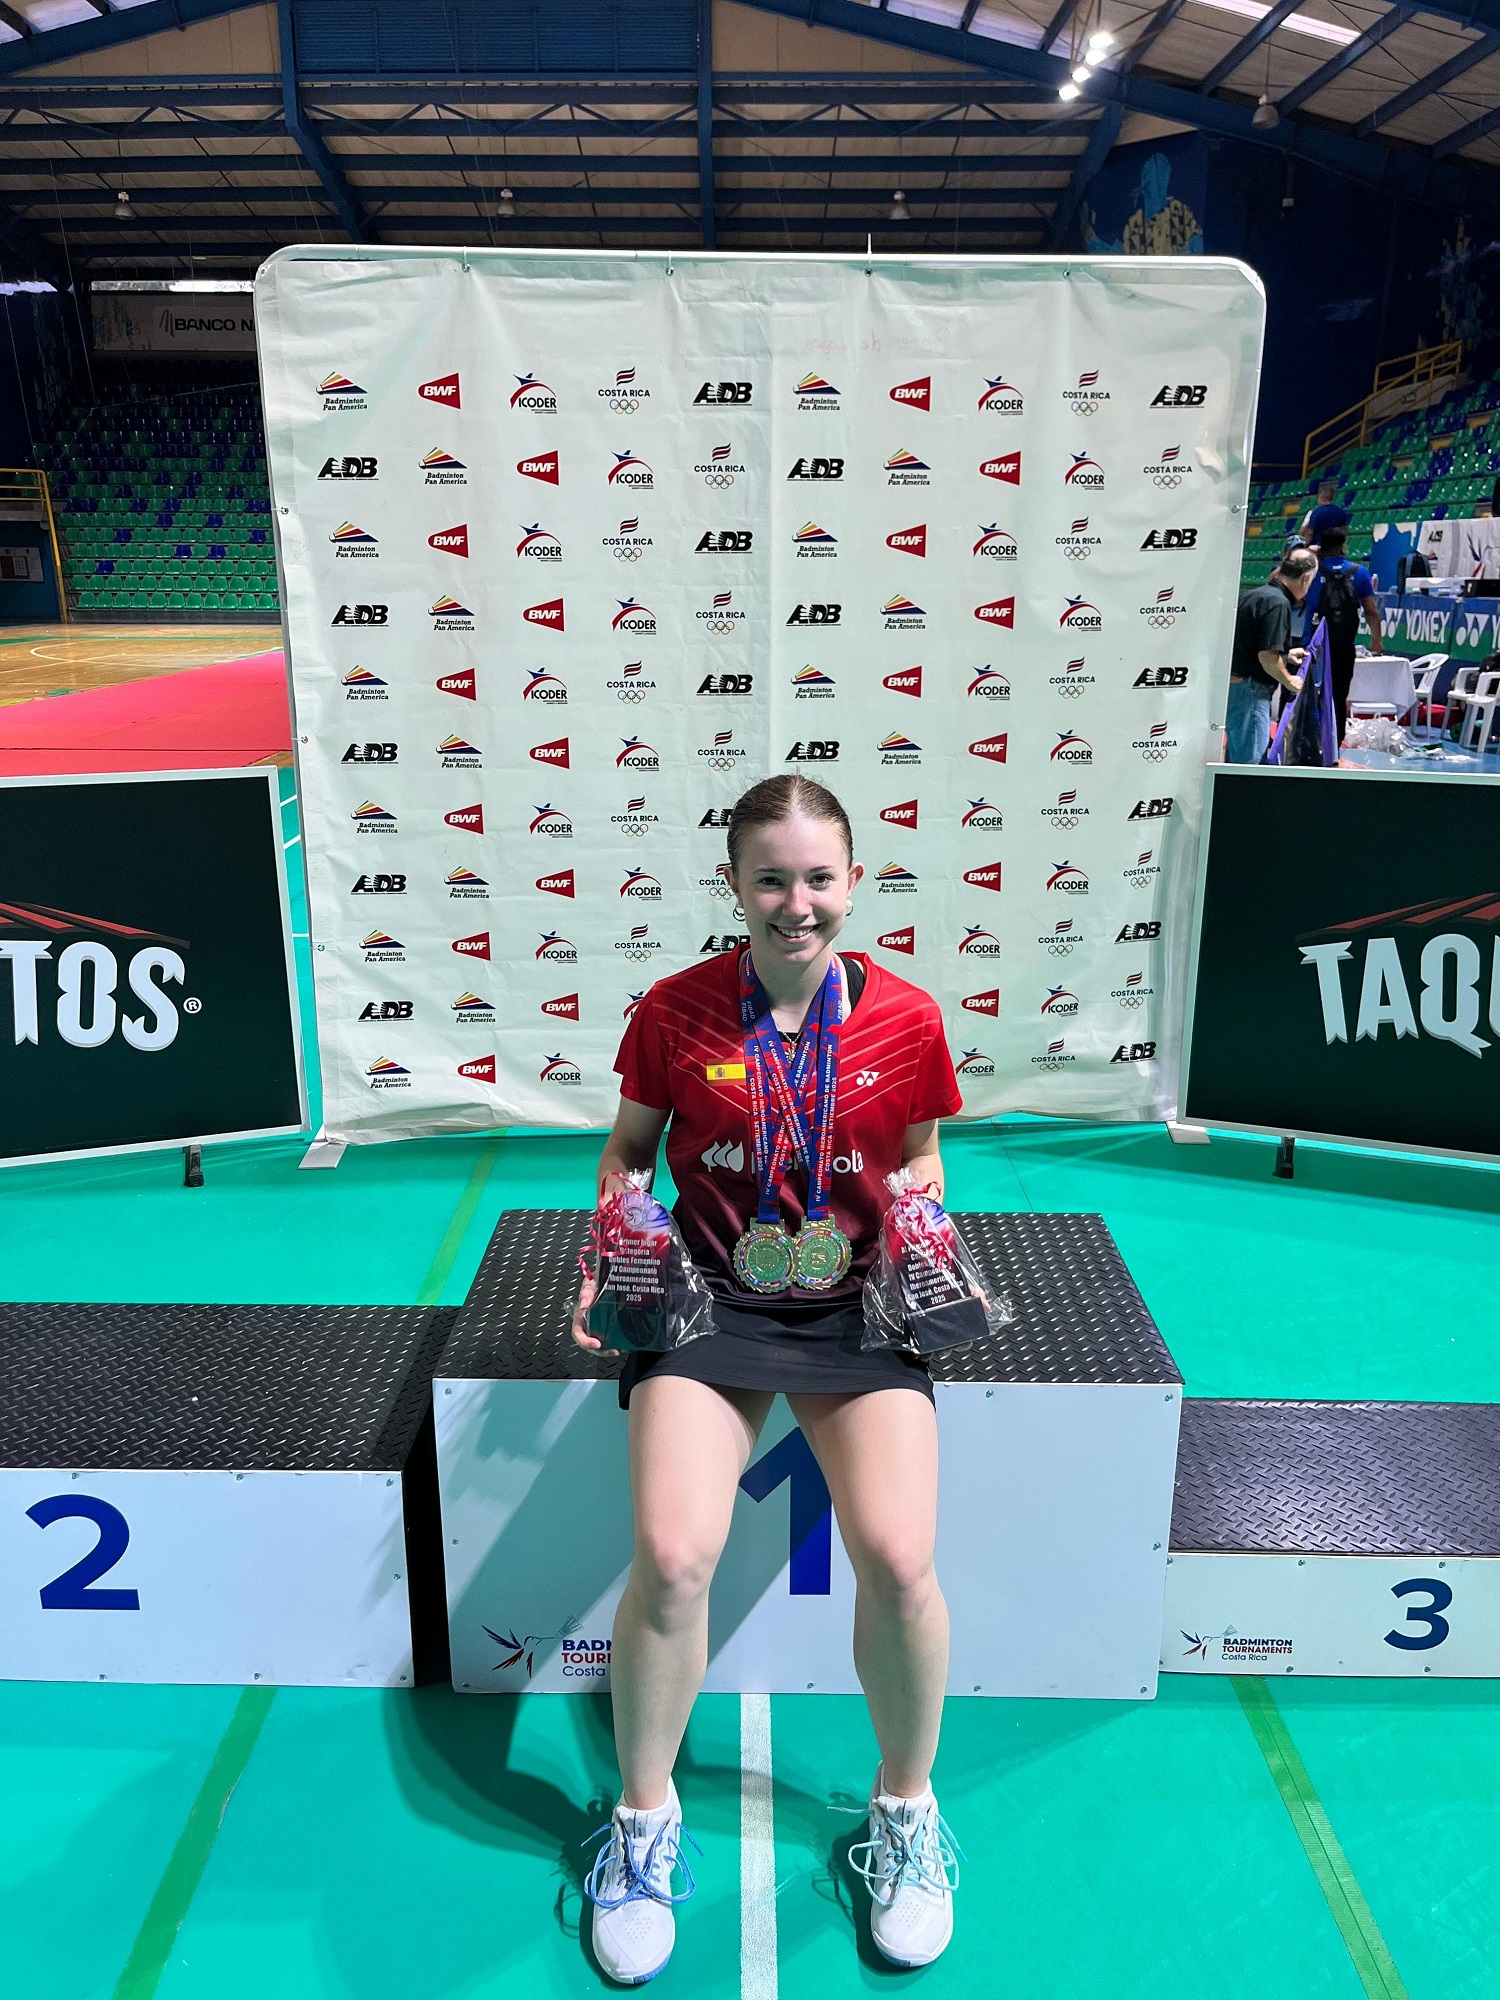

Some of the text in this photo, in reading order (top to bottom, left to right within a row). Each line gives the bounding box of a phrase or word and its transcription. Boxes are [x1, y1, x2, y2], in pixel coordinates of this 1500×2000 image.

[174, 318, 255, 331] BANCO N
[424, 386, 456, 396] BWF
[693, 382, 752, 403] ADB
[895, 389, 927, 398] BWF
[1063, 391, 1088, 399] COSTA
[1151, 385, 1207, 406] ADB
[324, 397, 365, 405] Badminton
[519, 397, 556, 408] ICODER
[800, 397, 838, 405] Badminton
[986, 400, 1023, 410] ICODER
[337, 403, 368, 411] America
[797, 402, 841, 411] Pan America
[434, 536, 464, 545] BWF
[695, 531, 753, 551] ADB
[891, 536, 923, 545] BWF
[1141, 529, 1197, 549] ADB
[525, 546, 562, 556] ICODER
[981, 546, 1017, 555] ICODER
[1405, 608, 1451, 644] YONEX
[341, 743, 398, 762] ADB
[785, 741, 839, 760] ADB
[973, 744, 1004, 752] BWF
[535, 749, 566, 757] BWF
[882, 753, 919, 761] Badminton
[1058, 750, 1092, 760] ICODER
[624, 757, 659, 766] ICODER
[968, 872, 998, 881] BWF
[351, 874, 406, 892] ADB
[1054, 881, 1088, 890] ICODER
[628, 887, 661, 896] ICODER
[1298, 933, 1500, 1059] TAQ
[1110, 1042, 1157, 1062] ADB
[462, 1065, 493, 1074] BWF
[962, 1065, 994, 1073] ICODER
[548, 1073, 581, 1081] ICODER
[630, 1256, 660, 1265] Femenino
[618, 1266, 658, 1274] Campeonato
[632, 1284, 650, 1292] Costa
[934, 1284, 950, 1293] Costa
[626, 1294, 642, 1302] 2025
[930, 1294, 946, 1304] 2025
[738, 1426, 832, 1595] 1
[25, 1493, 140, 1611] 2
[1383, 1577, 1453, 1651] 3
[1223, 1638, 1293, 1647] BADMINTON
[1222, 1646, 1293, 1654] TOURNAMENTS
[561, 1652, 611, 1664] TOUR
[1221, 1653, 1268, 1661] Costa Rica
[562, 1665, 606, 1677] Costa
